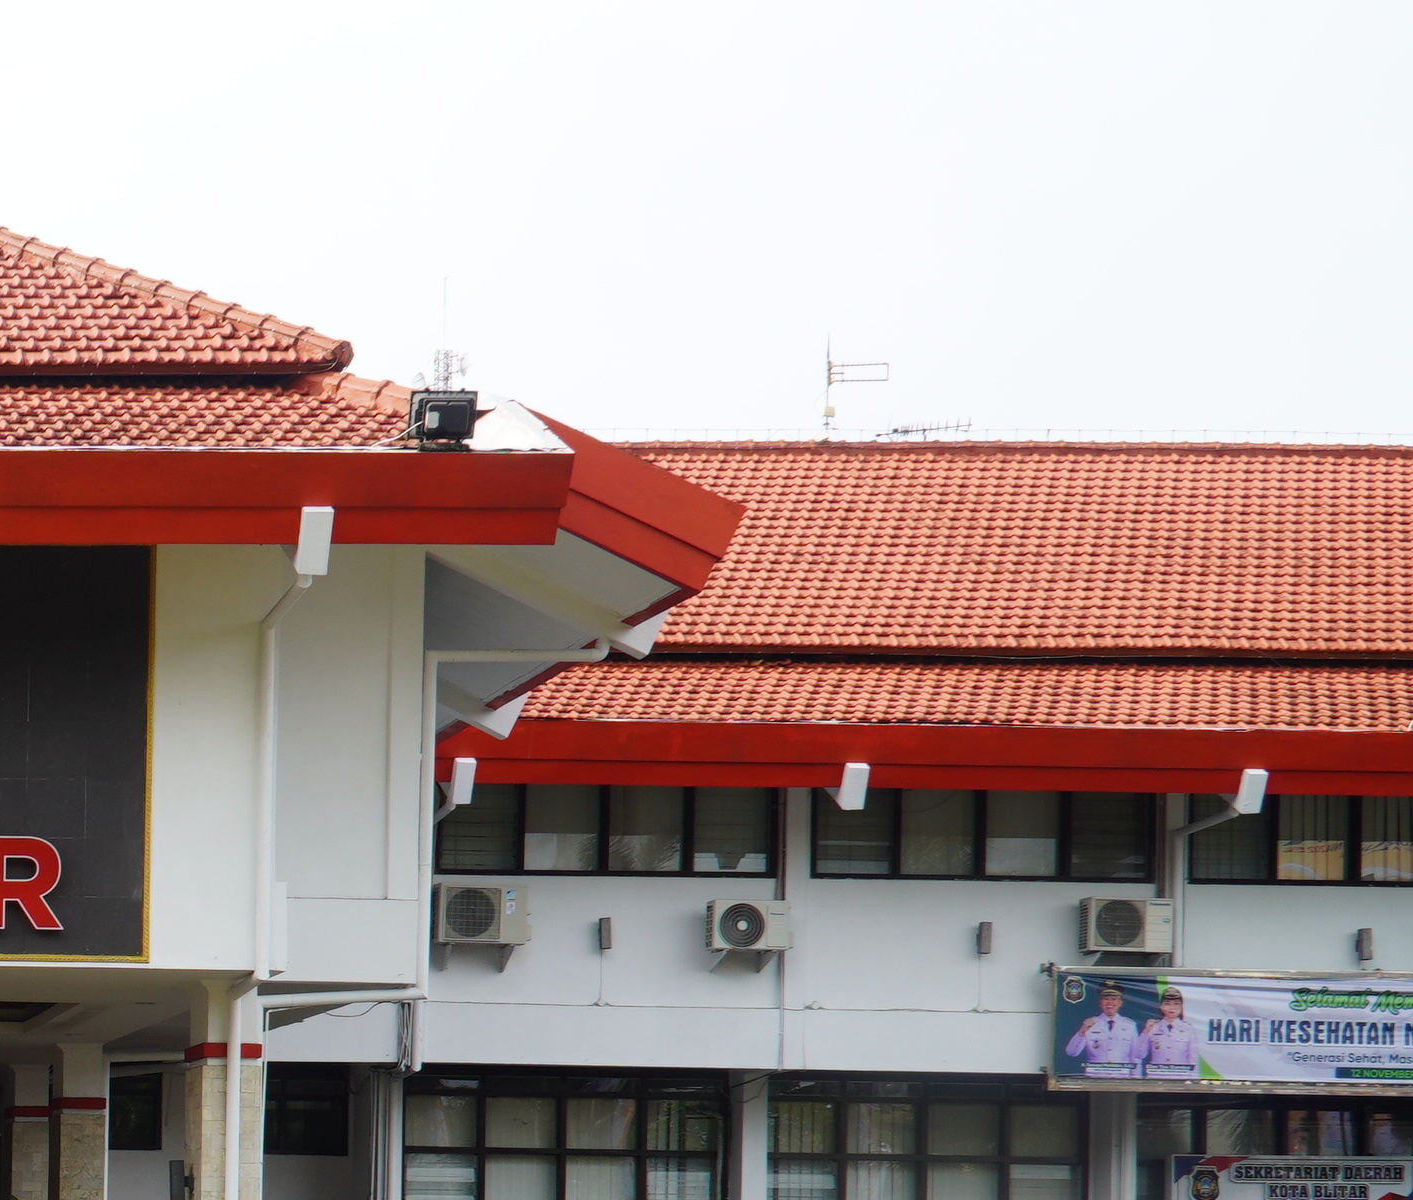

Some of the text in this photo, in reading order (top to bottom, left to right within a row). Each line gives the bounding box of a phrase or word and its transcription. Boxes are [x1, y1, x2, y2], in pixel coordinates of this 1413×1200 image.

[1289, 986, 1369, 1011] Selamat
[1207, 1018, 1261, 1043] HARI
[1269, 1019, 1395, 1046] KESEHATAN
[1347, 1052, 1385, 1065] Sehat,
[1389, 1054, 1413, 1064] Mas
[1351, 1069, 1413, 1078] 12 NOVEMBE
[1234, 1165, 1403, 1180] SEKRETARIAT DAERAH
[1269, 1185, 1368, 1199] KOTA BLITAR
